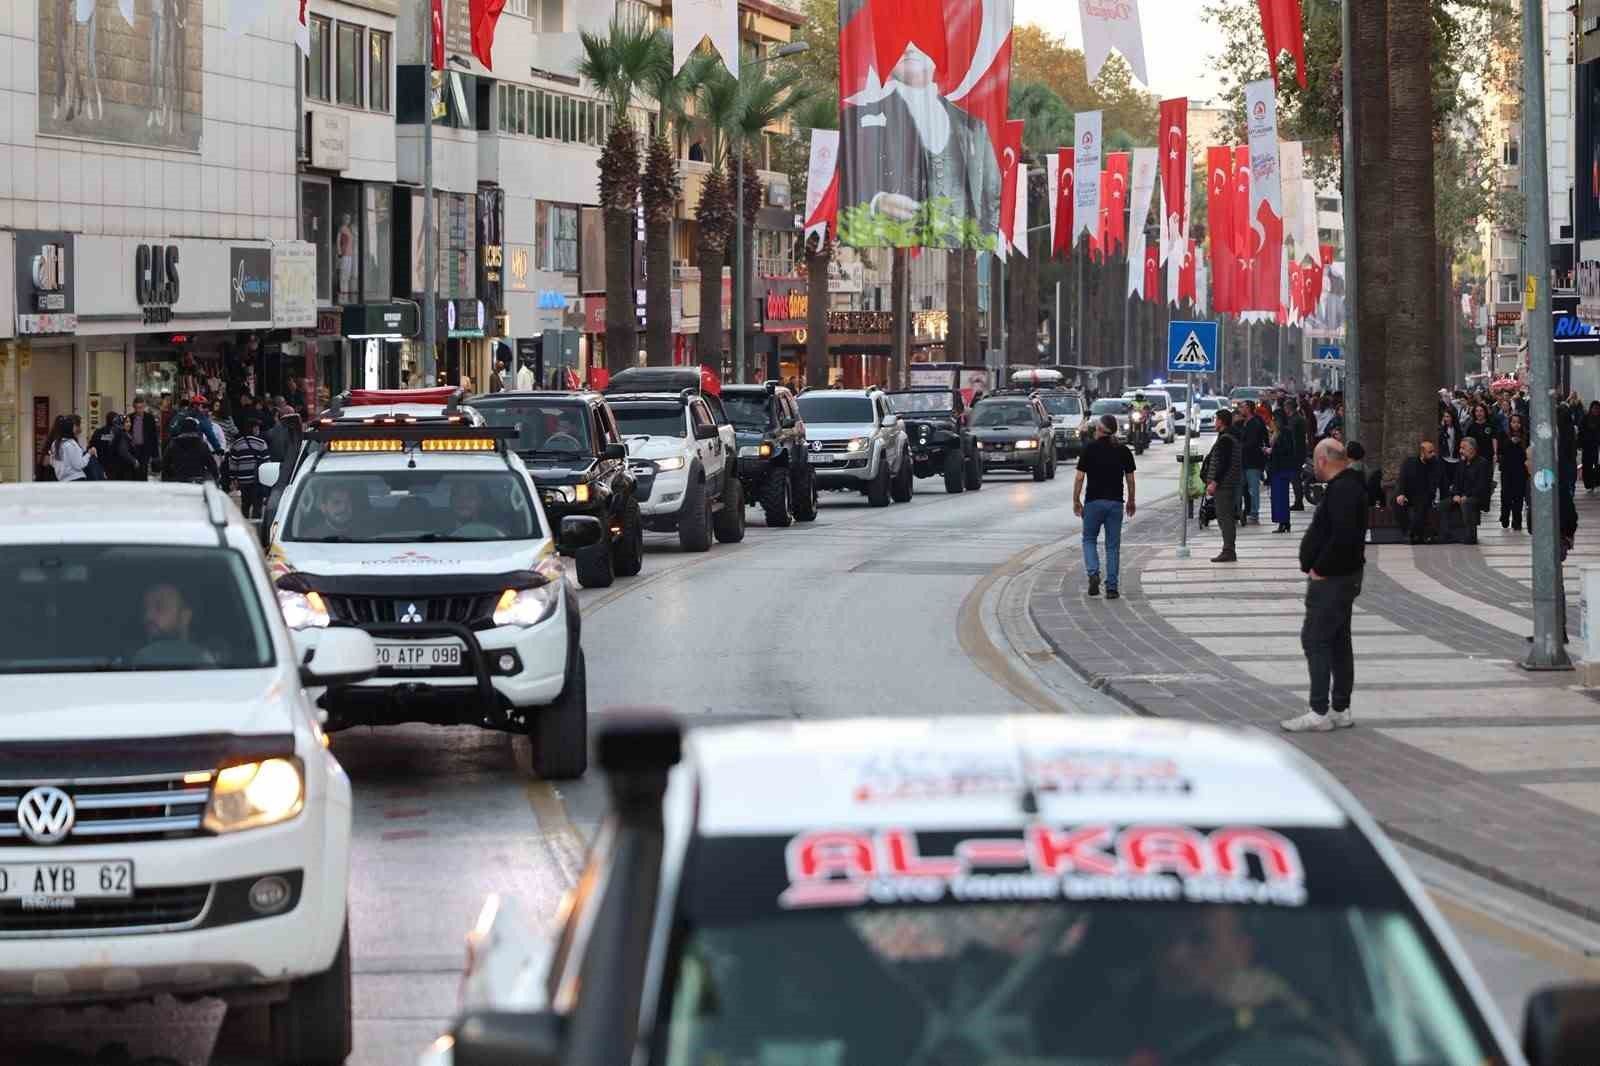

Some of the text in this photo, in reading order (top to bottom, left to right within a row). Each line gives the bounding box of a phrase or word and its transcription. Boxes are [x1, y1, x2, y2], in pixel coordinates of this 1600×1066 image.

[398, 647, 424, 663] ATP
[432, 647, 458, 663] 098
[34, 866, 75, 893] AYB
[100, 865, 127, 891] 62
